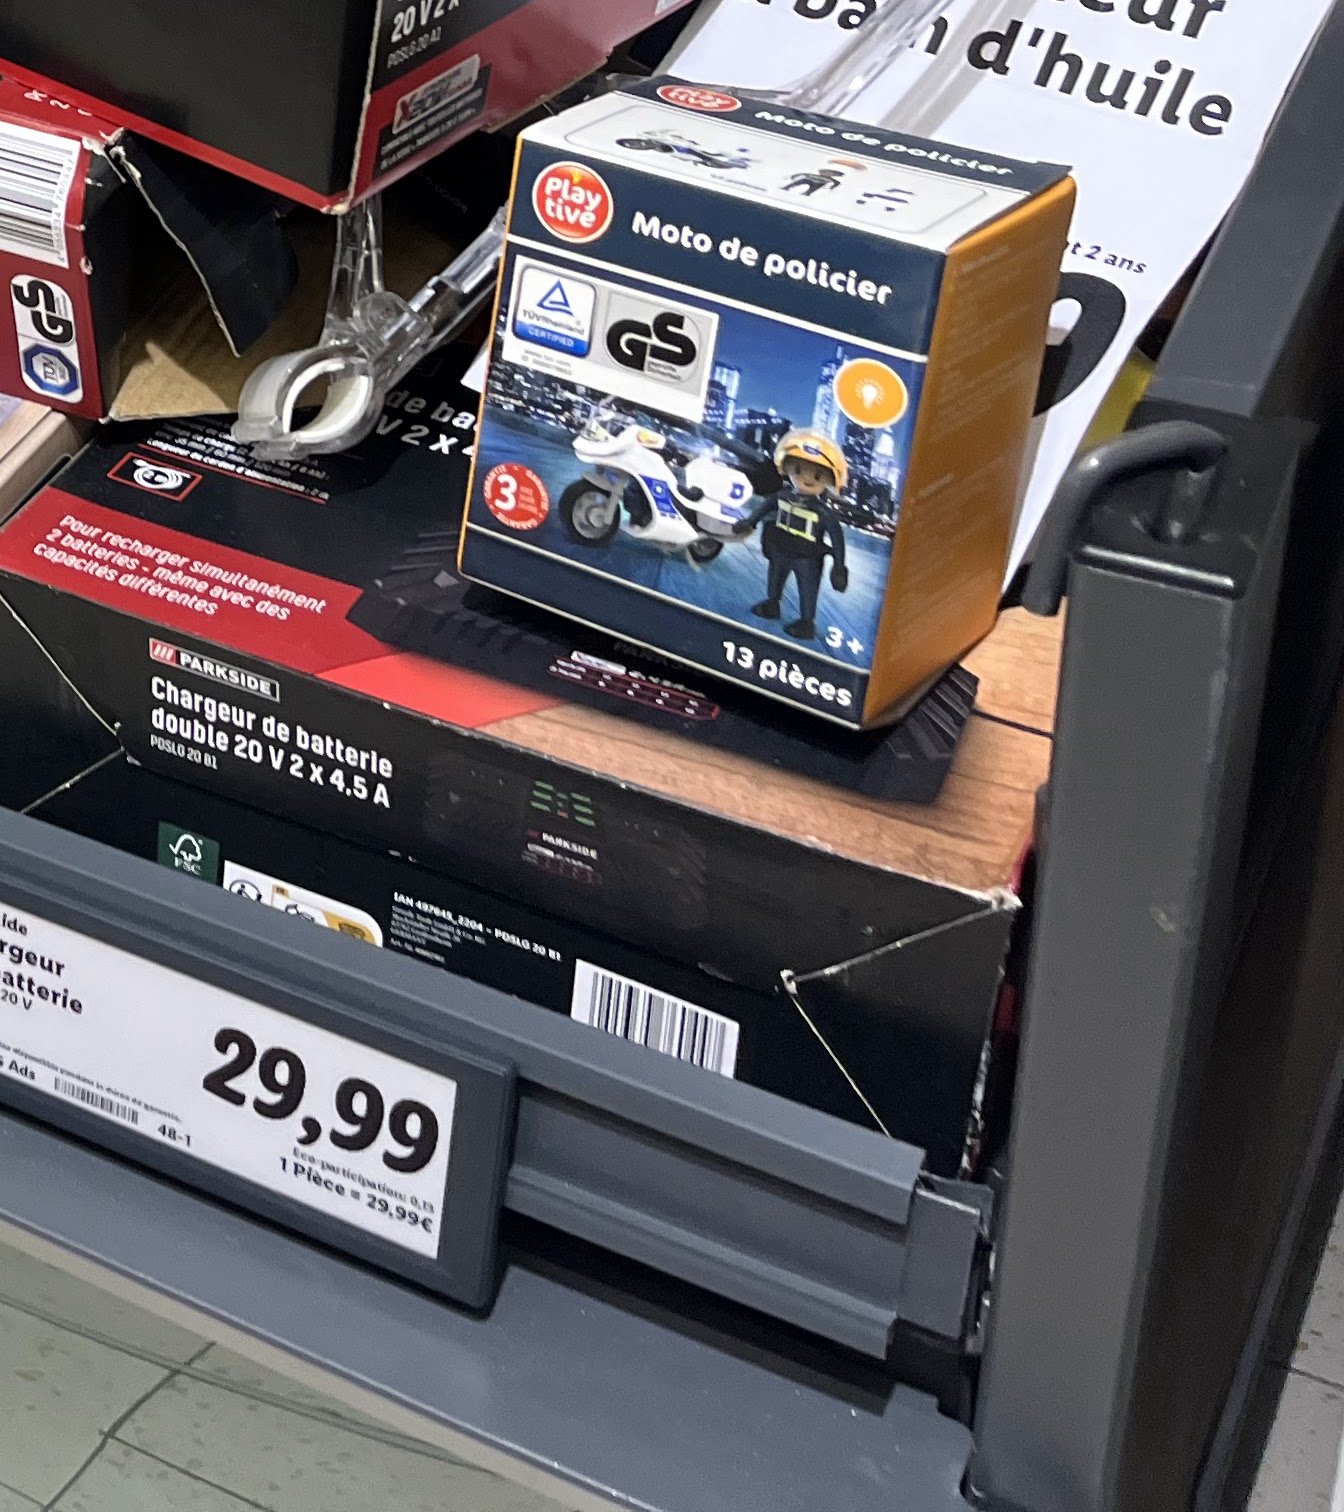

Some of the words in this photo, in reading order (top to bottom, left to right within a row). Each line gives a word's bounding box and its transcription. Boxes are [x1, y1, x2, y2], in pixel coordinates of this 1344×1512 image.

[967, 20, 1233, 137] d'huile
[545, 176, 603, 214] Play
[545, 196, 597, 229] tive
[632, 211, 713, 253] Moto
[718, 238, 757, 269] de
[763, 253, 893, 305] policier
[1084, 245, 1102, 260] 2
[1104, 253, 1147, 273] ans
[33, 542, 116, 581] capacités
[119, 572, 219, 616] différentes
[46, 528, 61, 542] 2
[60, 534, 139, 571] batteries
[154, 567, 207, 594] même
[209, 586, 255, 609] avec
[256, 599, 291, 620] des
[60, 515, 98, 538] Pour
[101, 526, 188, 569] recharger
[190, 558, 327, 614] simultanément
[180, 653, 272, 694] PARKSIDE
[722, 641, 753, 666] 13
[759, 657, 853, 707] pièces
[825, 626, 865, 656] 3+
[151, 676, 256, 730] Chargeur
[262, 715, 290, 742] de
[296, 729, 393, 778] batterie
[0, 990, 19, 1006] 20
[22, 997, 33, 1011] V
[202, 1027, 439, 1173] 29,99
[280, 1156, 288, 1172] 1
[293, 1161, 346, 1197] Pièce
[367, 1193, 433, 1233] 29,99€
